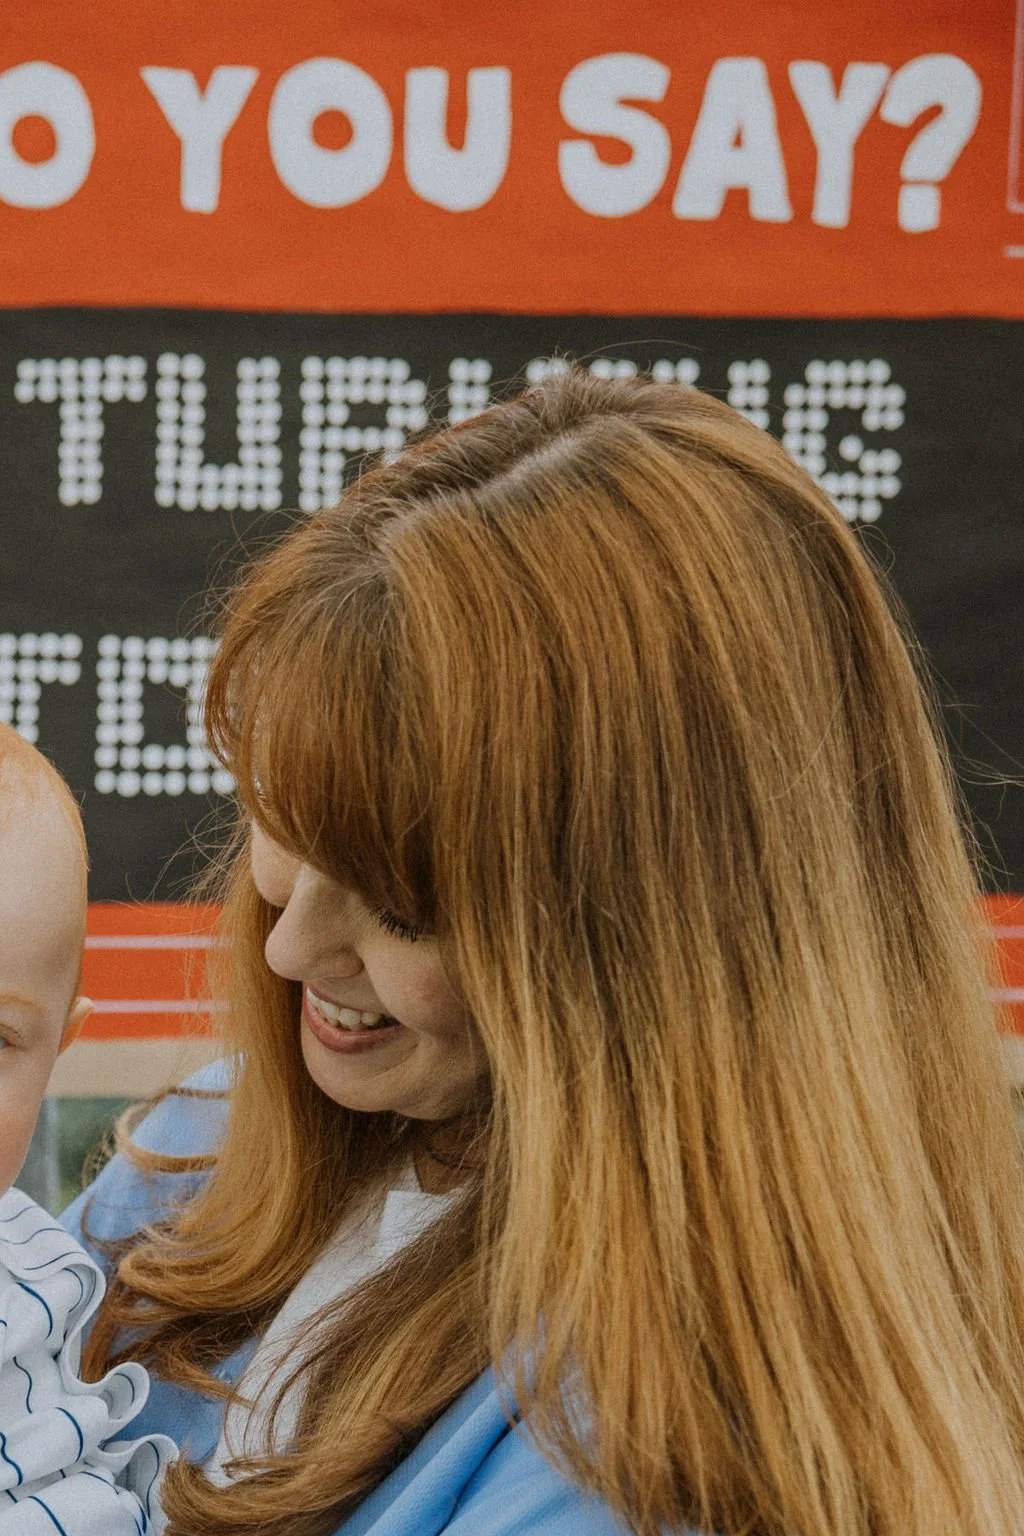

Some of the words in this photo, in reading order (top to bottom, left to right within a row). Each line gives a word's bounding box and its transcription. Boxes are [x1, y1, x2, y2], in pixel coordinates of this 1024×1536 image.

[142, 58, 511, 212] YOU
[560, 54, 980, 231] SAY?
[14, 352, 906, 523] TURG
